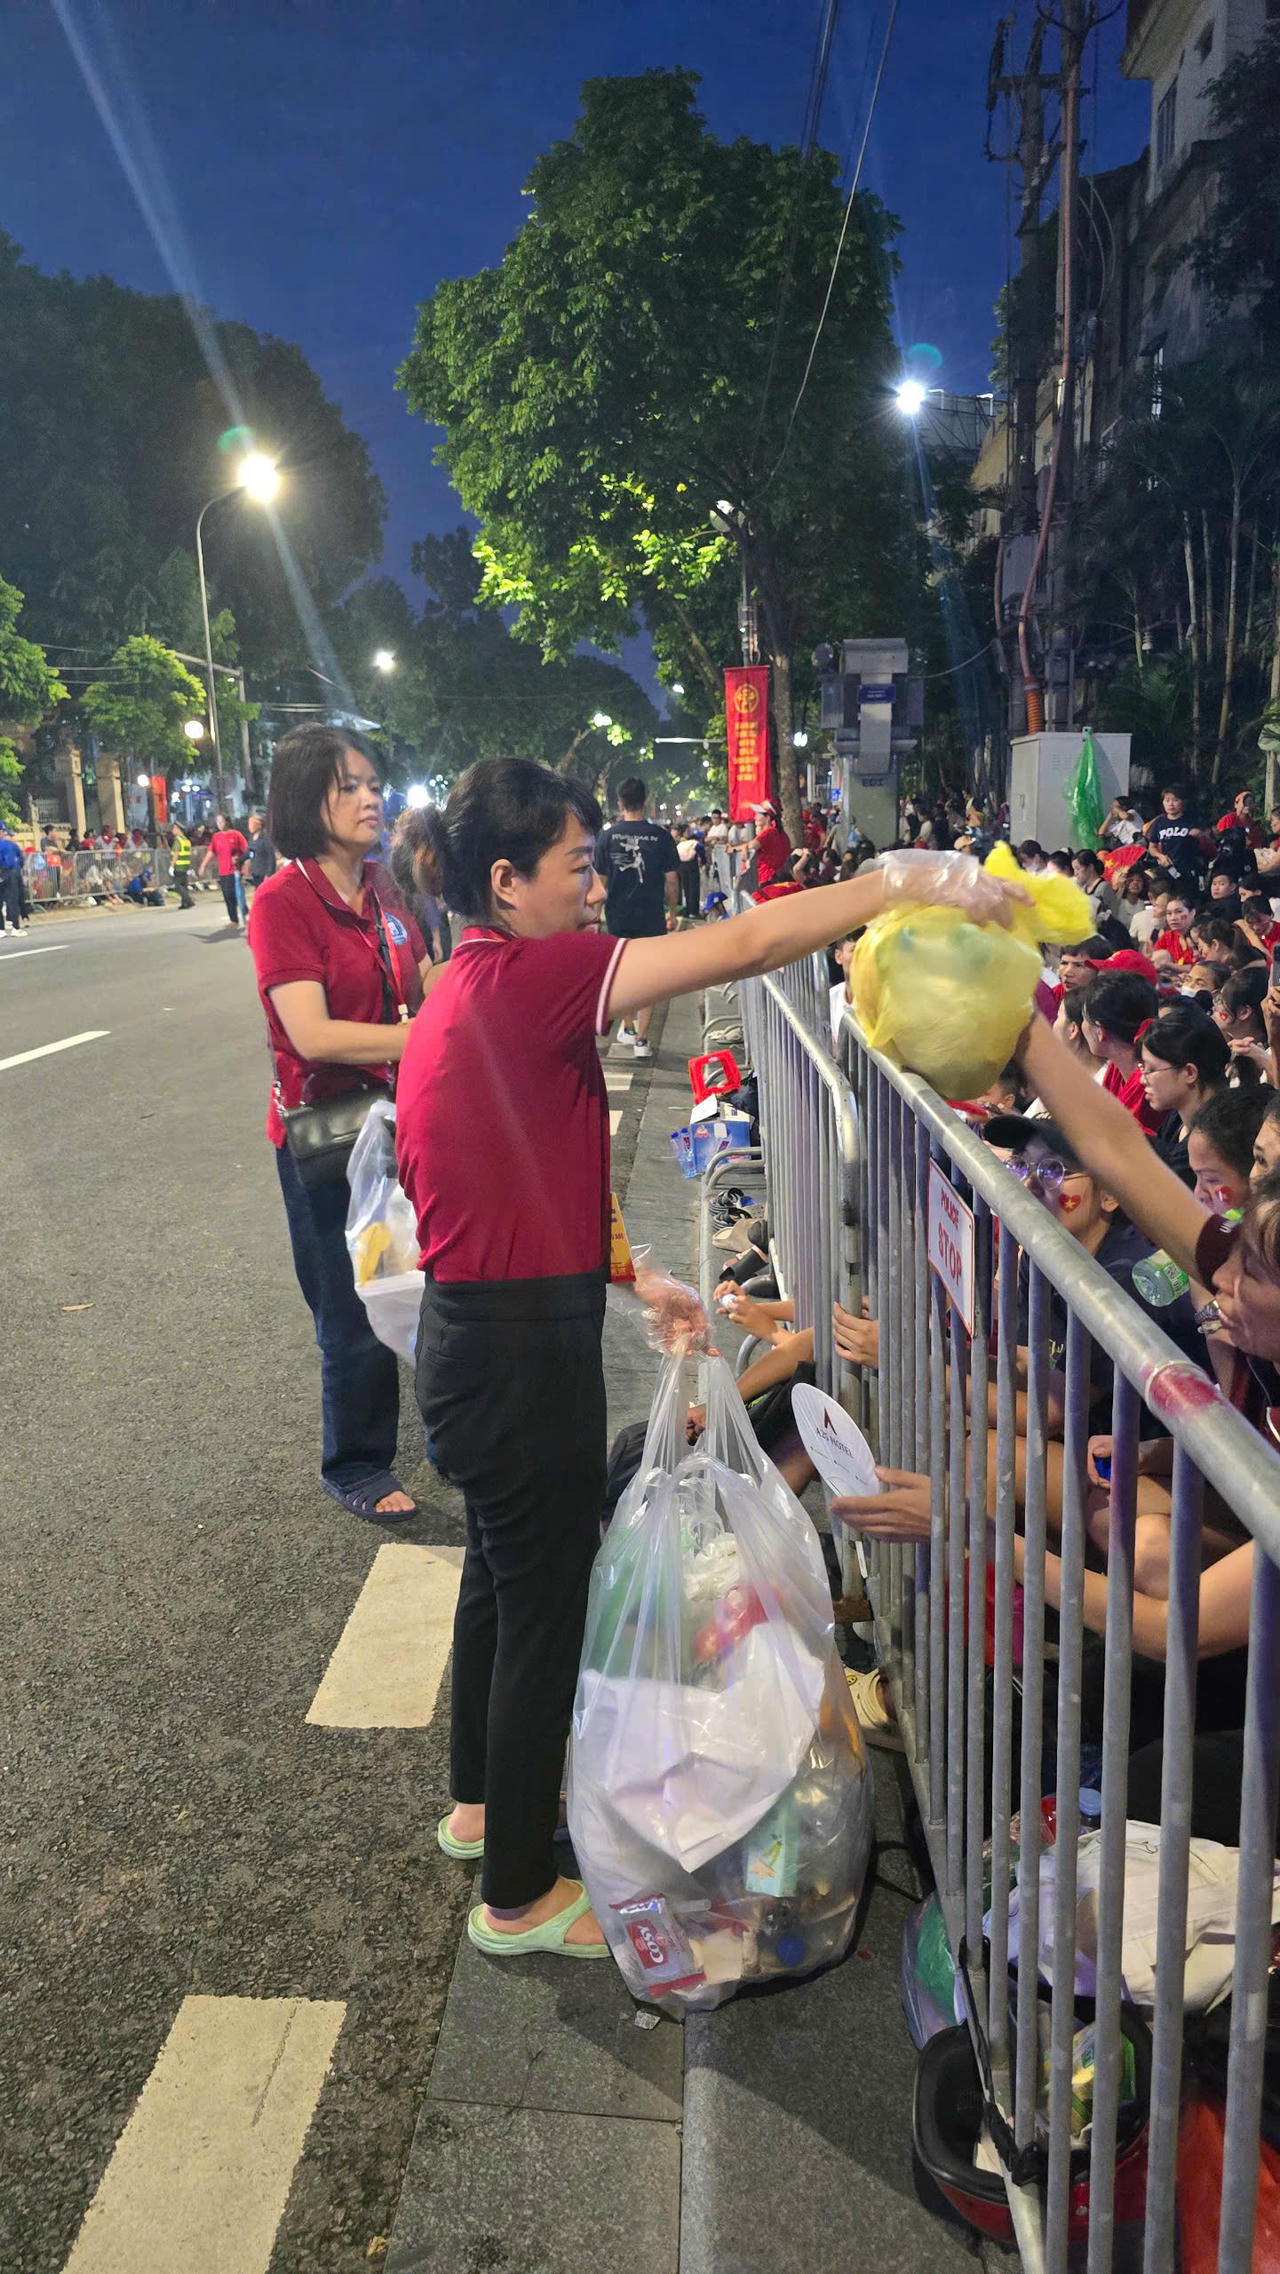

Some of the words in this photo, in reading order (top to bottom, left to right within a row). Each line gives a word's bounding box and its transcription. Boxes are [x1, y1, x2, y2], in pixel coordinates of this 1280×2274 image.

[1159, 827, 1189, 840] POLO
[938, 1221, 962, 1288] STOP
[637, 1925, 664, 1963] COSY
